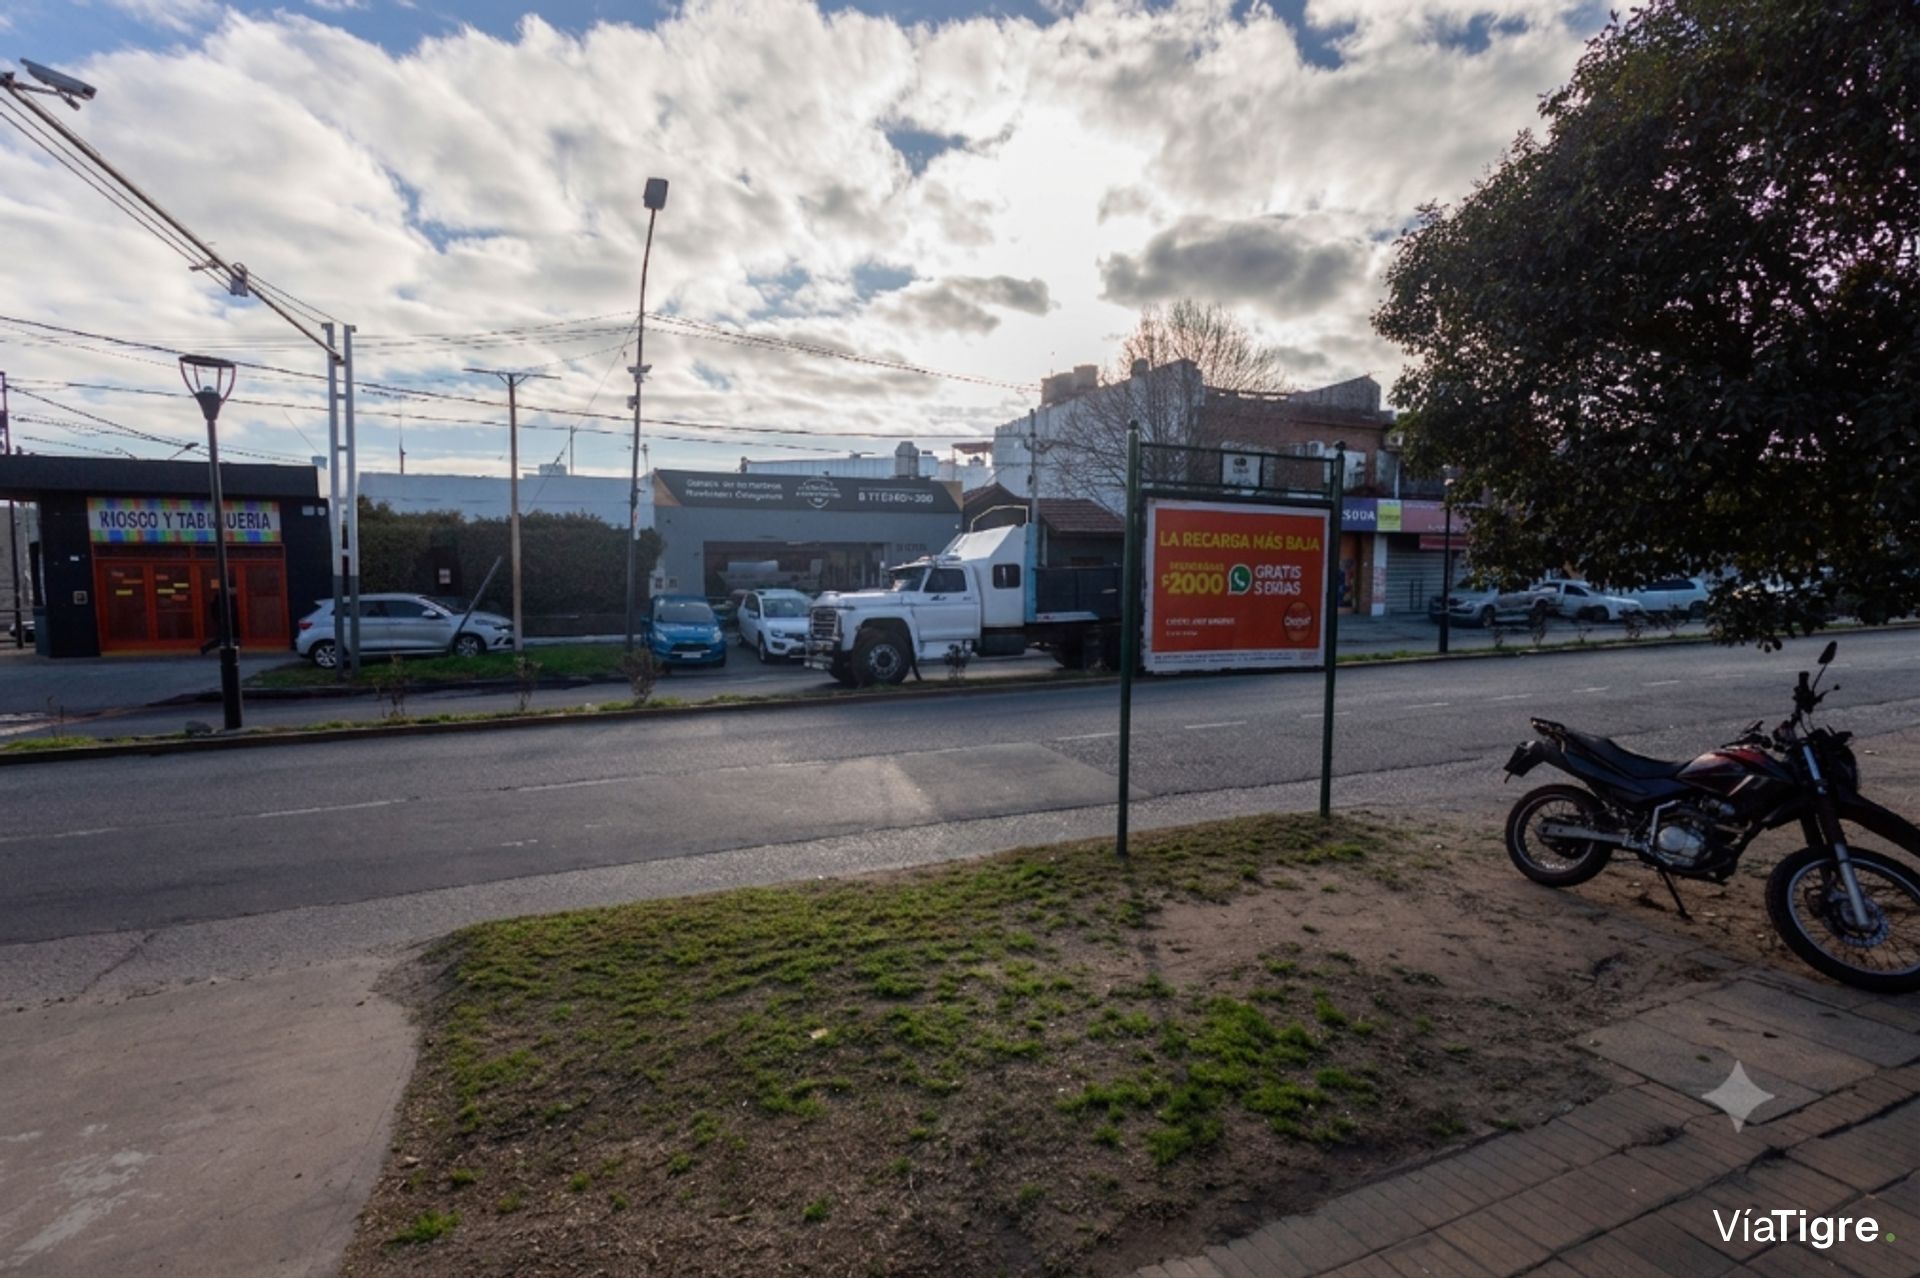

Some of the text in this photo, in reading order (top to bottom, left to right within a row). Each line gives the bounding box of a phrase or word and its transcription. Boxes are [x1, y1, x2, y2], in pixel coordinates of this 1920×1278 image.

[99, 511, 158, 529] KIOSCO
[163, 512, 173, 529] Y
[1159, 530, 1321, 551] LA RECARGA MÁS BAJA
[1254, 564, 1302, 580] GRATIS
